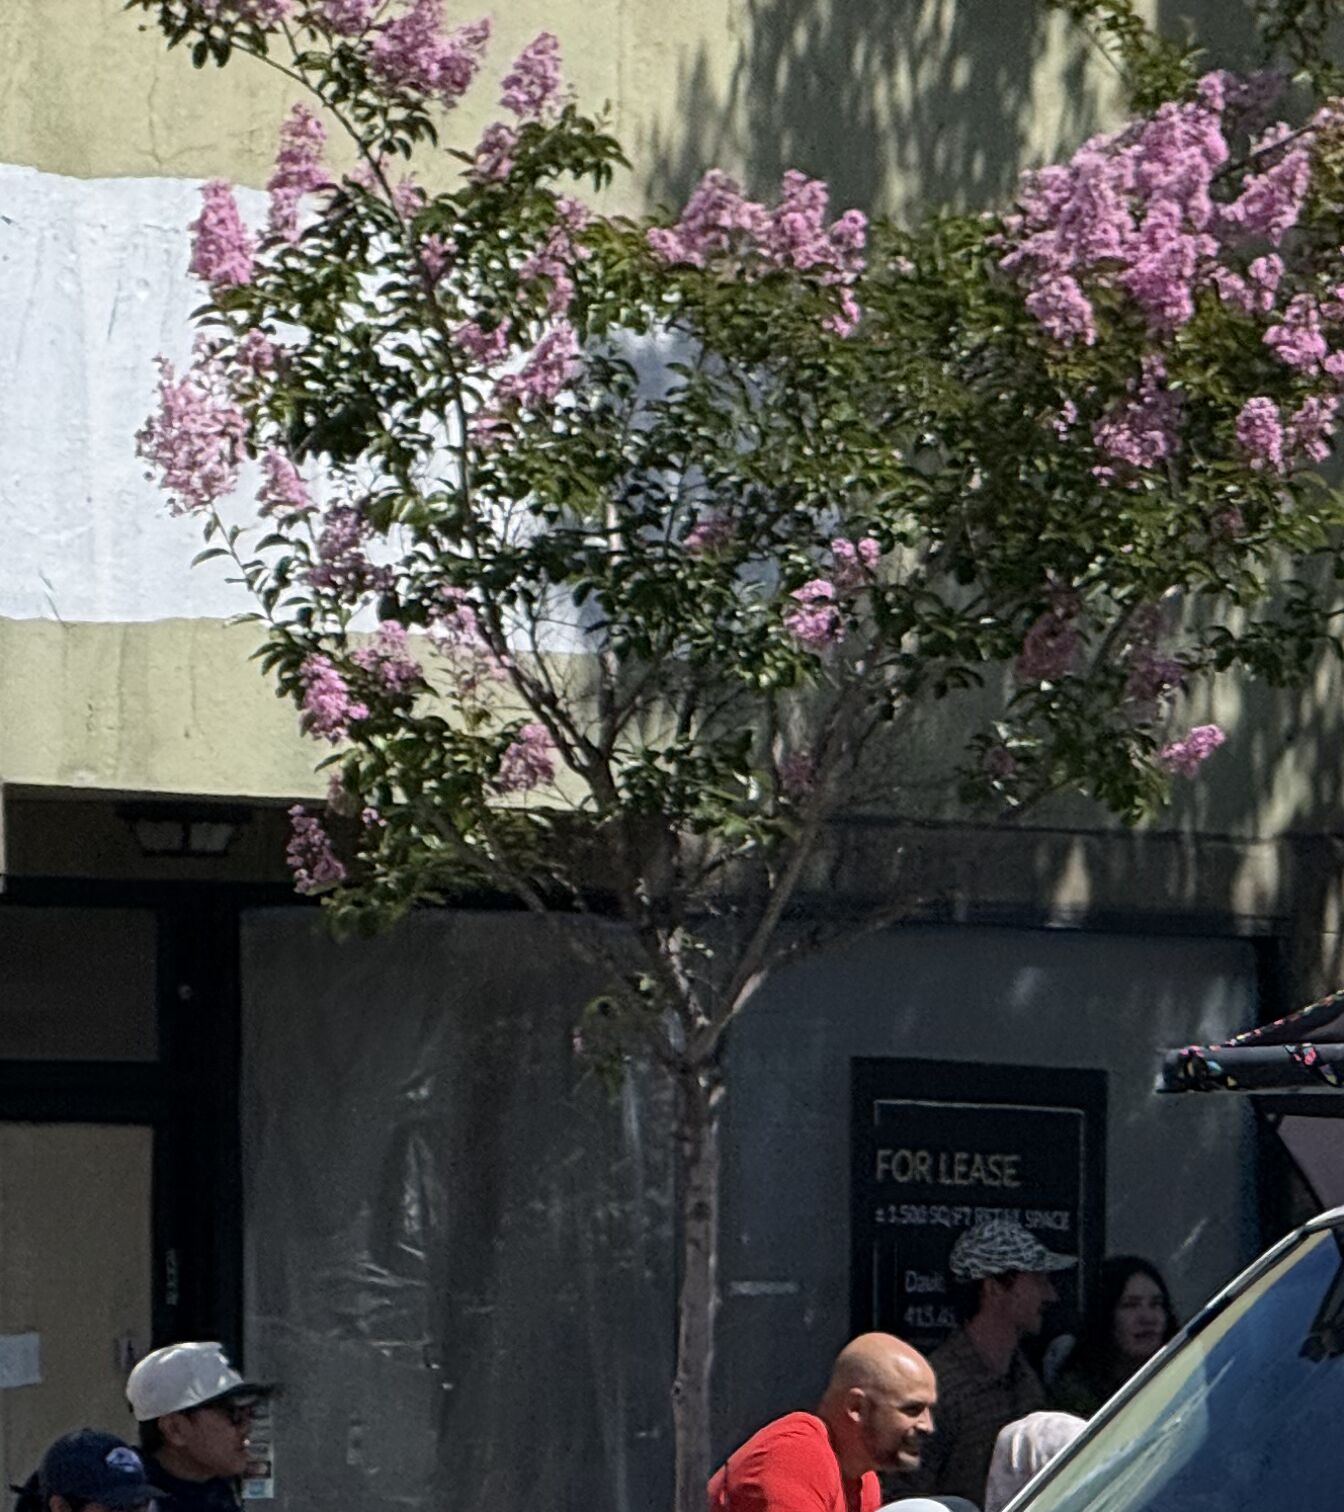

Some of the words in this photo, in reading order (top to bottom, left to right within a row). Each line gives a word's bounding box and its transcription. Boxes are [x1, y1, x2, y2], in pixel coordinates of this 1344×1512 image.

[876, 1149, 932, 1183] FOR
[938, 1152, 1022, 1187] LEASE
[1025, 1210, 1070, 1230] SPACE
